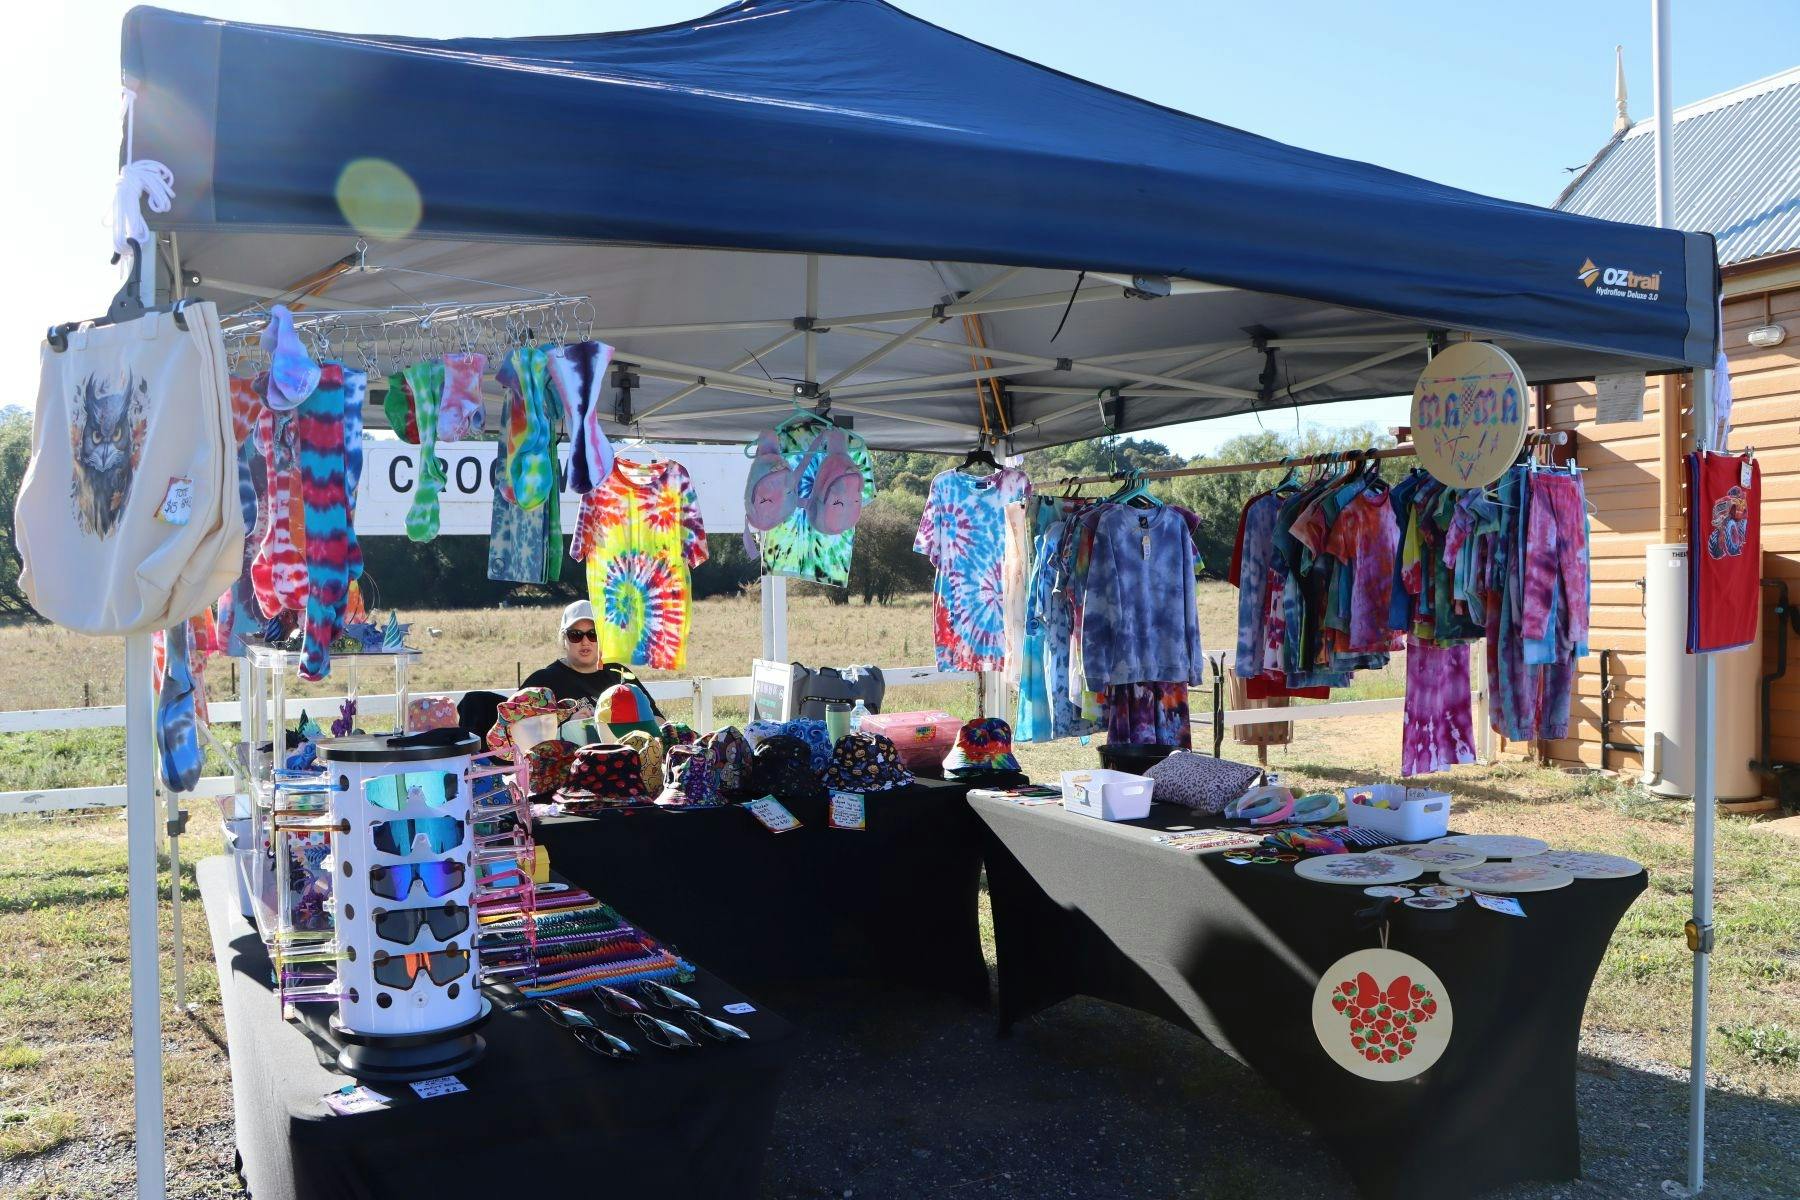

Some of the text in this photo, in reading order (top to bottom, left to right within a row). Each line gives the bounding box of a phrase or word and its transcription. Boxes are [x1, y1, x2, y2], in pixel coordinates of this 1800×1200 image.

[1603, 267, 1659, 290] OZtrail
[1596, 286, 1658, 301] Hydroflow Deluxe 3.0
